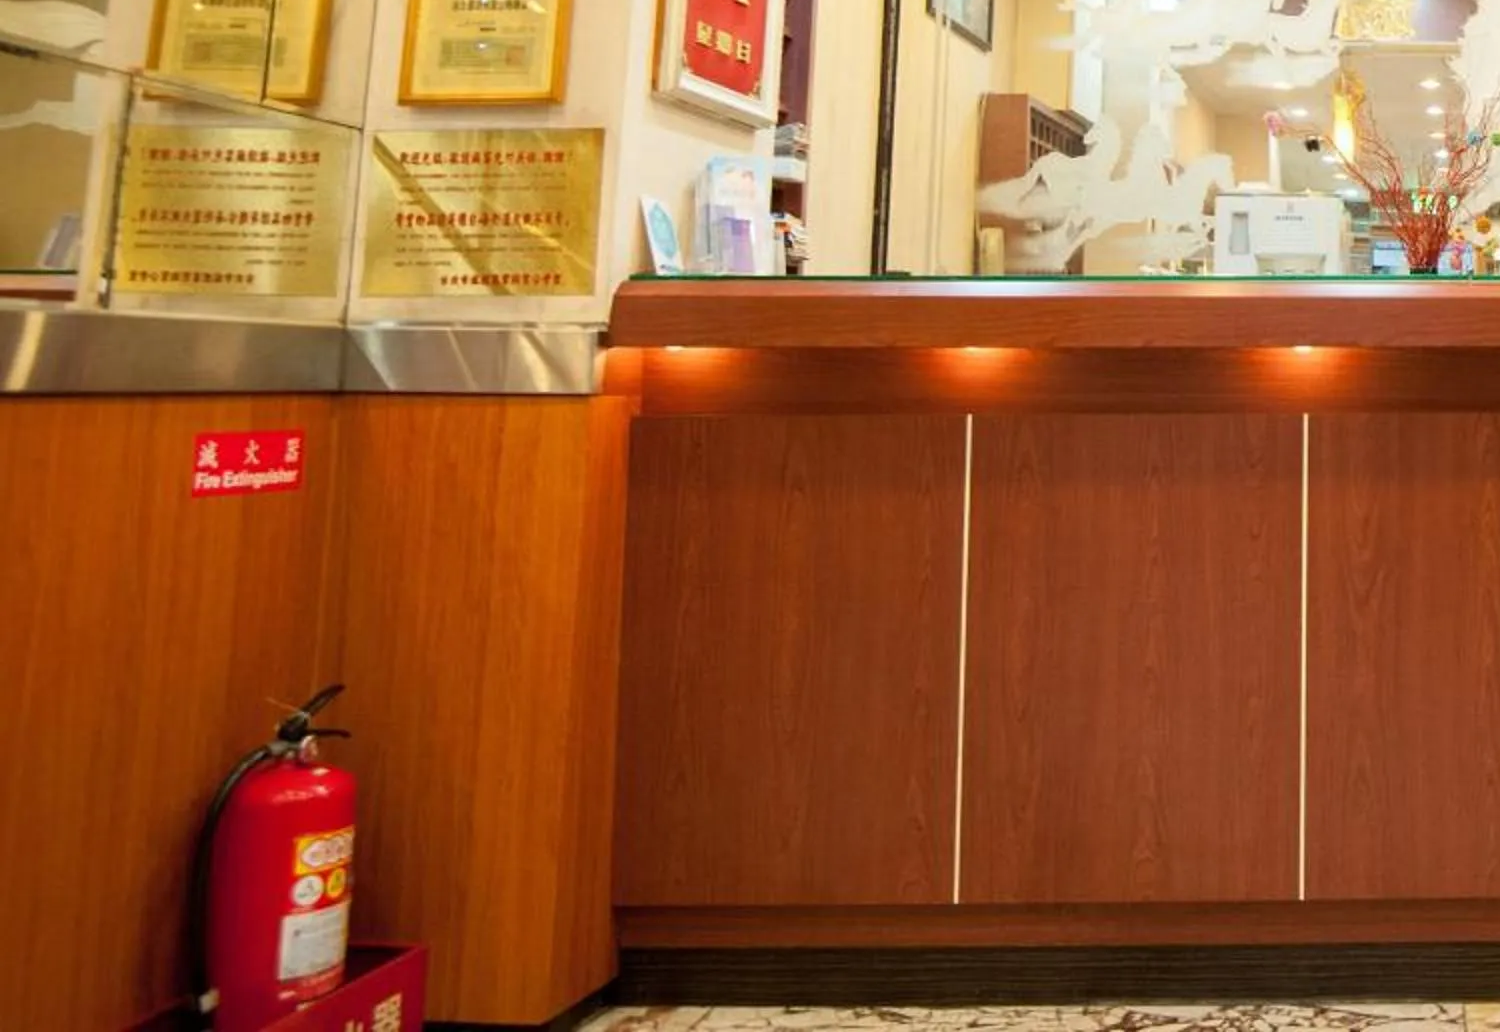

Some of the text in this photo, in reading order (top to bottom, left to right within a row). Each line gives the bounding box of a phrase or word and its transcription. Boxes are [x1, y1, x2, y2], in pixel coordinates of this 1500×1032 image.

[198, 438, 300, 468] 滅火器
[195, 468, 298, 490] Fire Extinguisher
